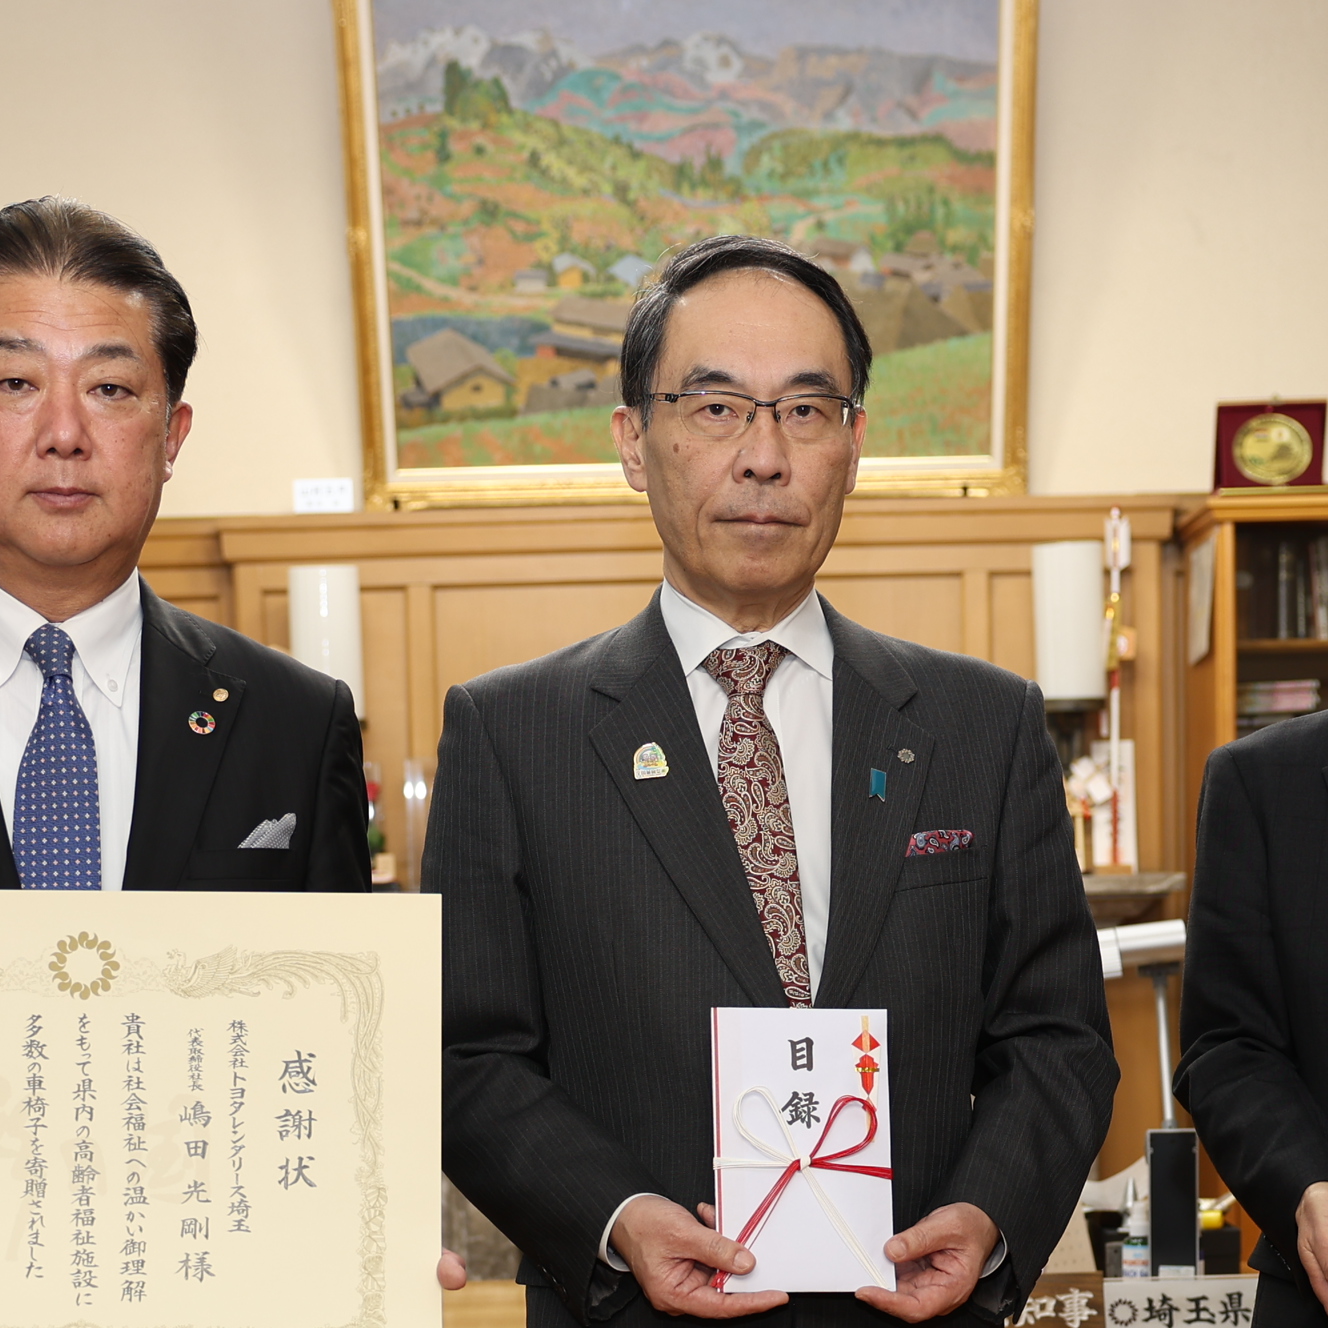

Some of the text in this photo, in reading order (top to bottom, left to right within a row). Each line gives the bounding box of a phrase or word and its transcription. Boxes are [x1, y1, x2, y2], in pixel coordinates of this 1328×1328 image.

[22, 1014, 50, 1279] 多数の車椅子を寄贈されました
[71, 1013, 100, 1307] をもって県内の高齢者福祉施設に
[120, 1013, 150, 1303] 貴社は社会福祉への温かい御理解
[227, 1020, 252, 1233] 株式会社トヨタレンタリース埼玉
[274, 1050, 318, 1191] 感謝状
[781, 1037, 821, 1129] 目録
